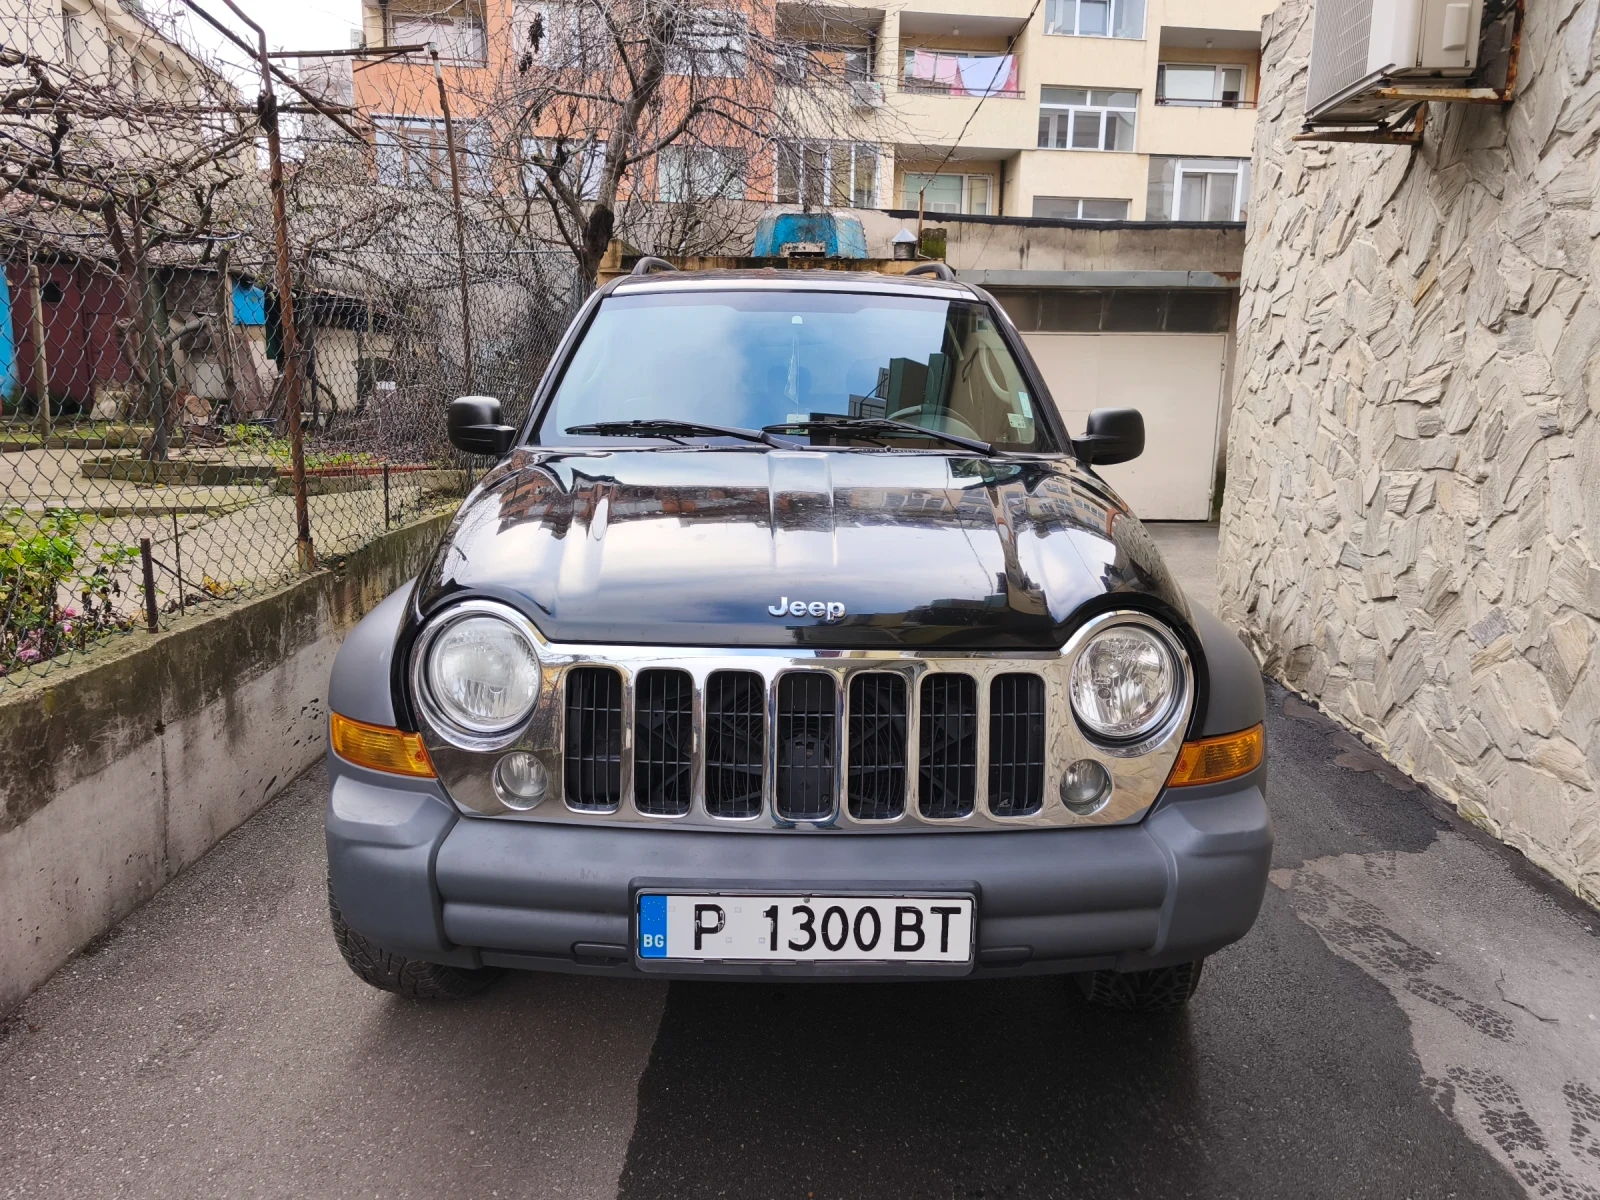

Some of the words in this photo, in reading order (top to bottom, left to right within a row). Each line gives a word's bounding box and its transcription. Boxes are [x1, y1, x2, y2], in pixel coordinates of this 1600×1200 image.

[768, 596, 846, 623] Jeep
[643, 933, 664, 948] BG
[694, 903, 726, 951] P
[763, 904, 882, 952] 1300
[893, 905, 962, 953] BT
